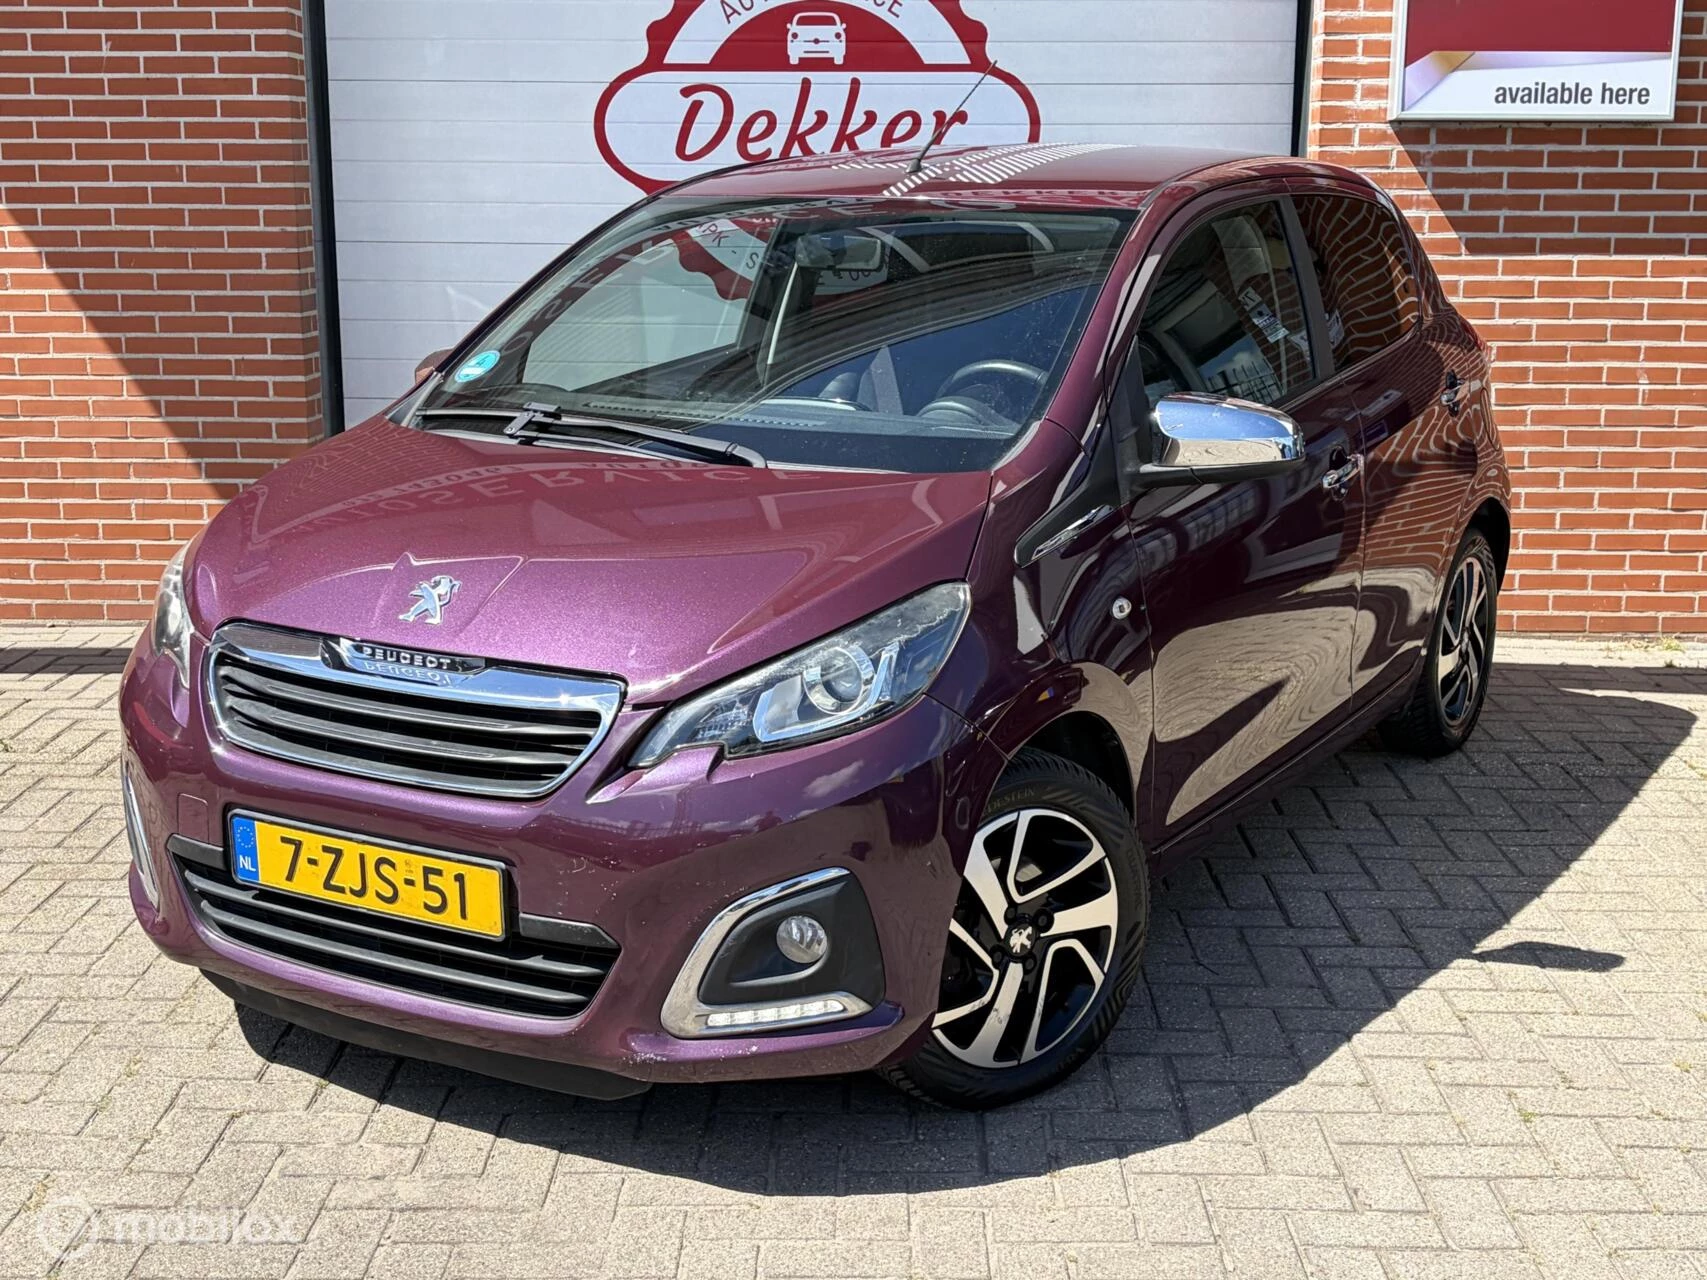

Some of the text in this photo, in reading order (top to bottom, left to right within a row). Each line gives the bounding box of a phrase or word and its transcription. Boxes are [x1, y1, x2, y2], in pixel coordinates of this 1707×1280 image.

[1494, 82, 1650, 105] available here
[674, 77, 968, 162] Dekker
[362, 646, 451, 670] PEUGEOT
[239, 854, 257, 872] NL
[280, 835, 468, 920] 7-ZJS-51
